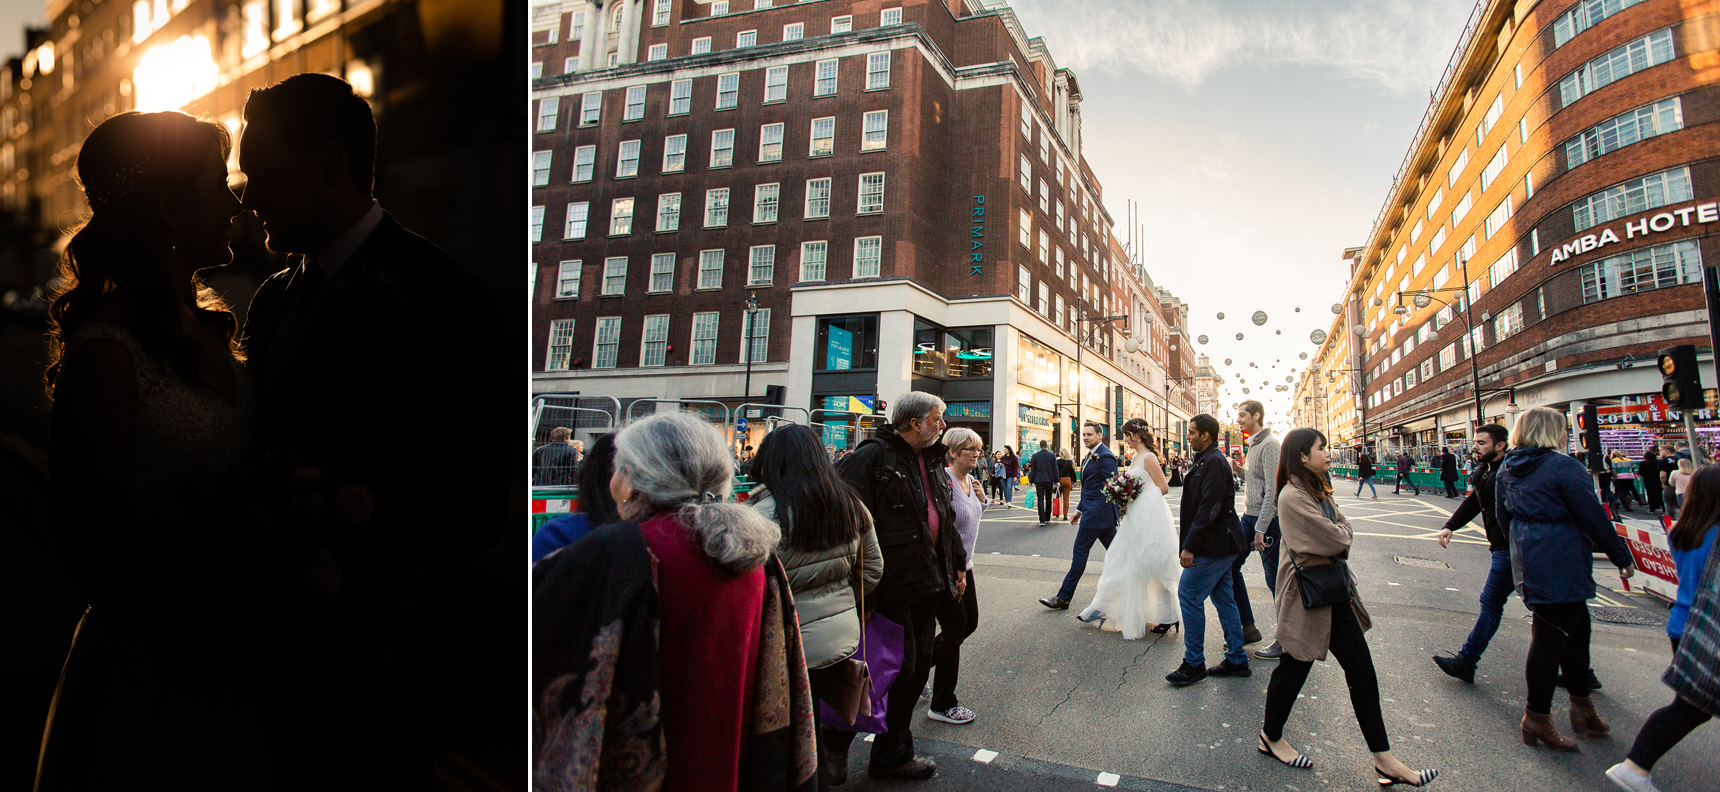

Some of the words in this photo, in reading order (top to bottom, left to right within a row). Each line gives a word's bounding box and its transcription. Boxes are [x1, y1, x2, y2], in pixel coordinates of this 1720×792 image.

[970, 195, 985, 276] PRIMARK
[1550, 228, 1620, 266] AMBA
[1625, 202, 1720, 239] HOTE
[1620, 394, 1668, 406] GIF
[699, 406, 764, 419] PRIMAK
[944, 405, 988, 418] MARK
[1648, 404, 1658, 412] &
[1596, 409, 1720, 425] SOUVENR
